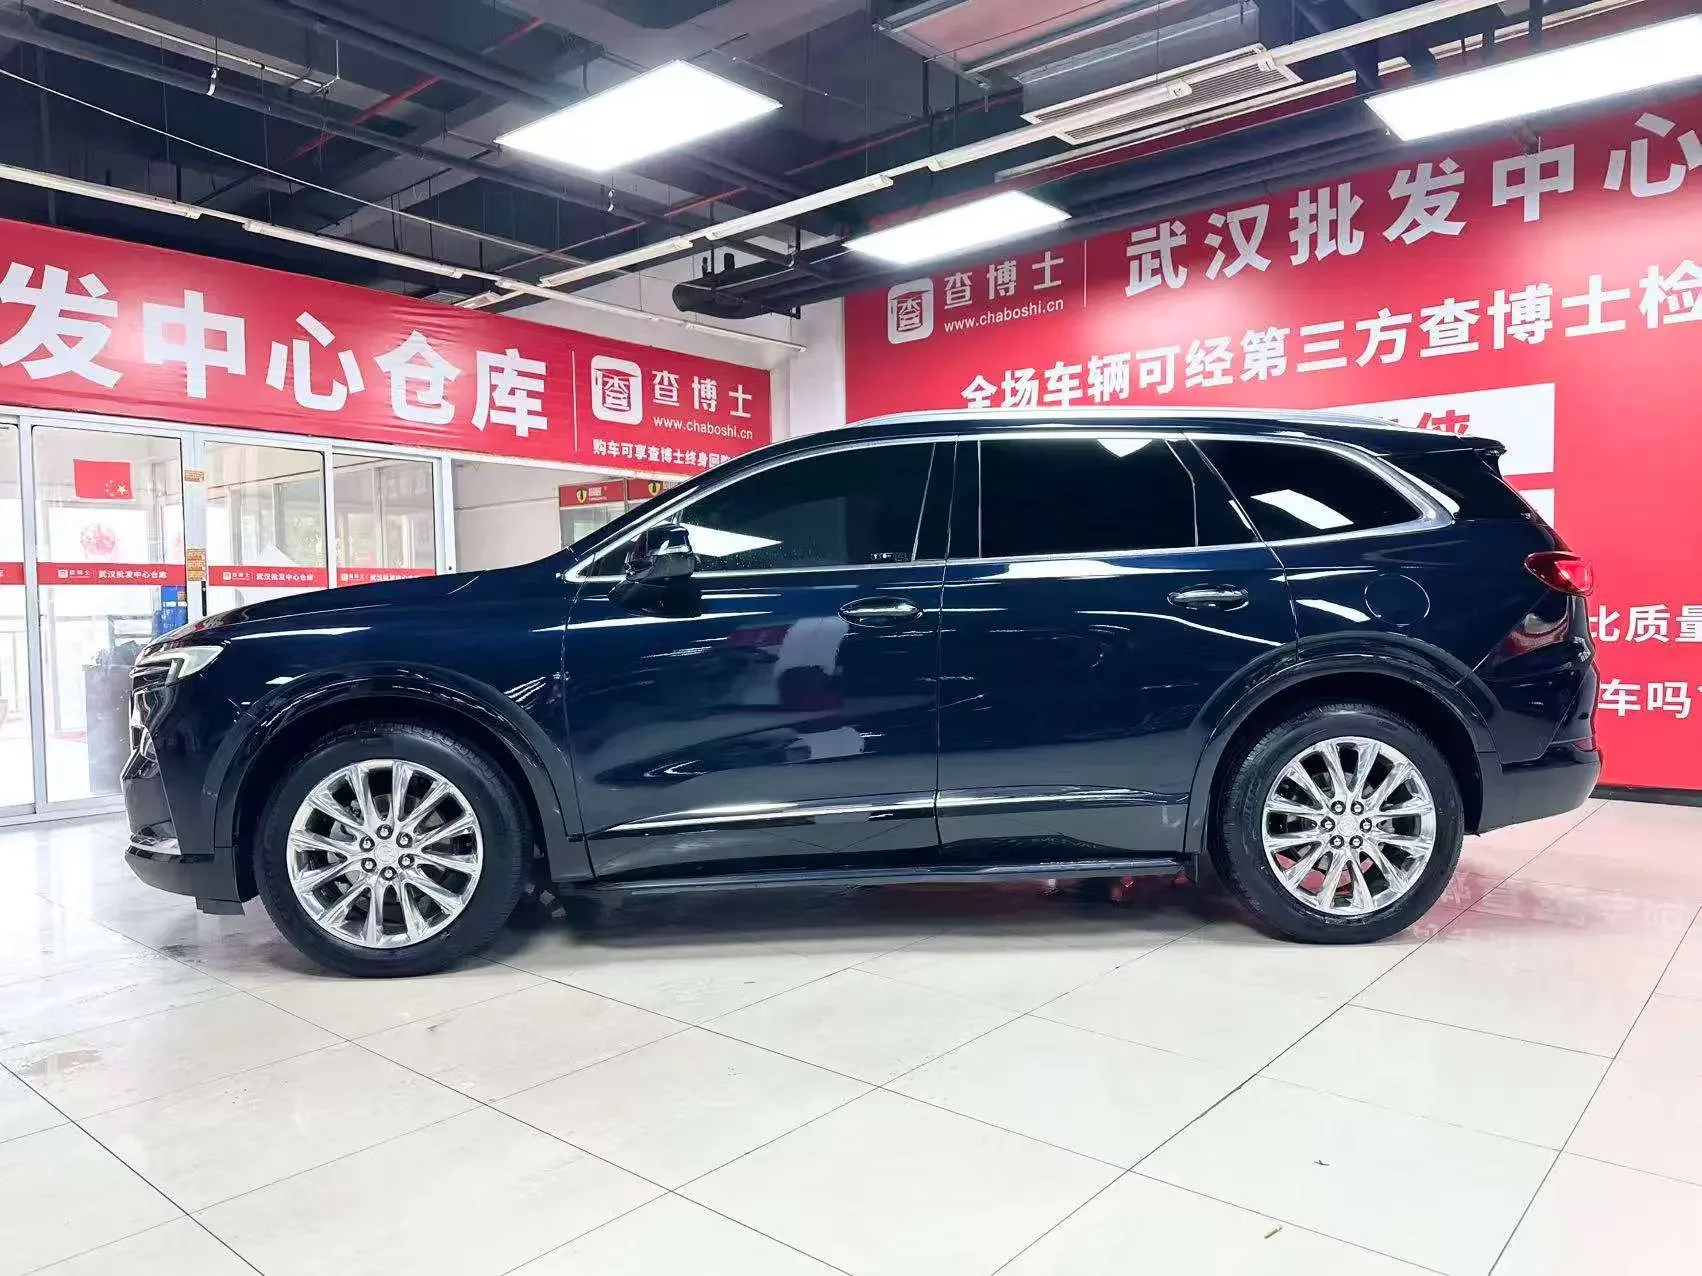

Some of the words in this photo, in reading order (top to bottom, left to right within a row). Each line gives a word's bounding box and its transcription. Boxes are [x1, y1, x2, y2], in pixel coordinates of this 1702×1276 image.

[1125, 112, 1702, 297] 武汉批发中心
[944, 250, 1064, 310] 查博士
[944, 299, 1064, 333] www.chaboshi.cn
[961, 258, 1702, 409] 全场车辆可经第三方查博士检
[0, 262, 548, 438] 发中心仓库
[652, 370, 753, 419] 查博士
[653, 415, 753, 440] www.chaboshi.cn
[1598, 678, 1702, 719] 车吗
